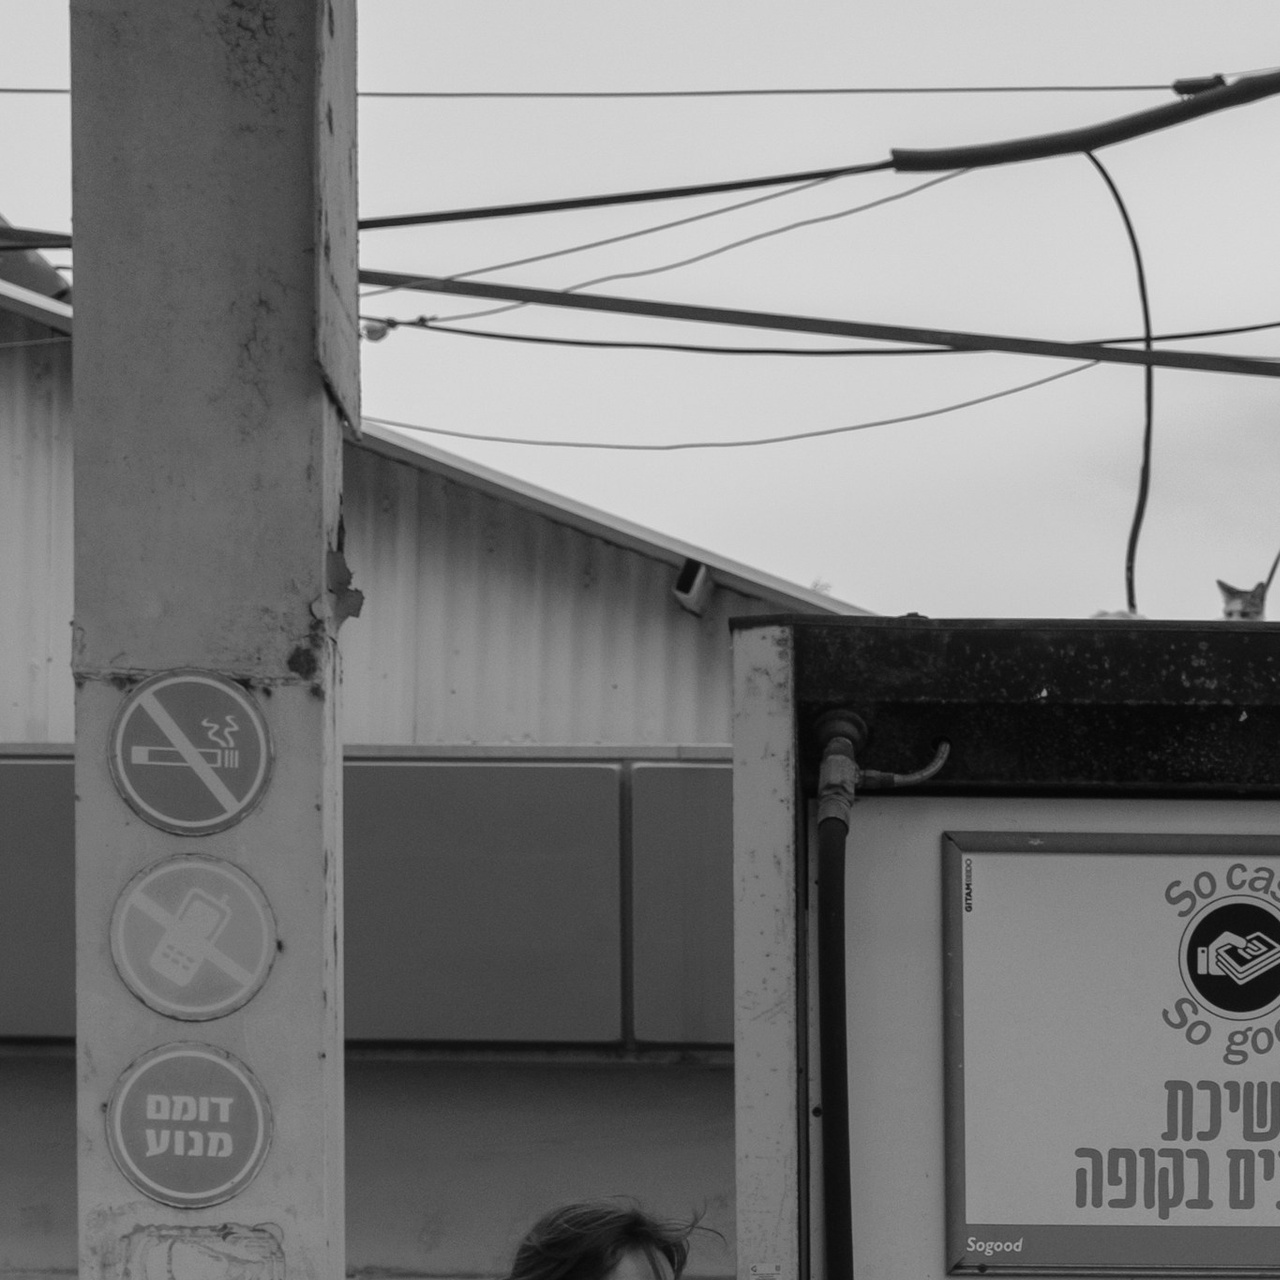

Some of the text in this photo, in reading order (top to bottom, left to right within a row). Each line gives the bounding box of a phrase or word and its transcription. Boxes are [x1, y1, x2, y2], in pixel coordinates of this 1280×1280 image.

[1164, 871, 1218, 918] So
[1162, 996, 1213, 1046] So
[146, 1094, 234, 1123] דומם
[145, 1128, 234, 1158] מנוע
[1074, 1147, 1214, 1221] בקופה
[966, 1235, 1024, 1256] Sogood
